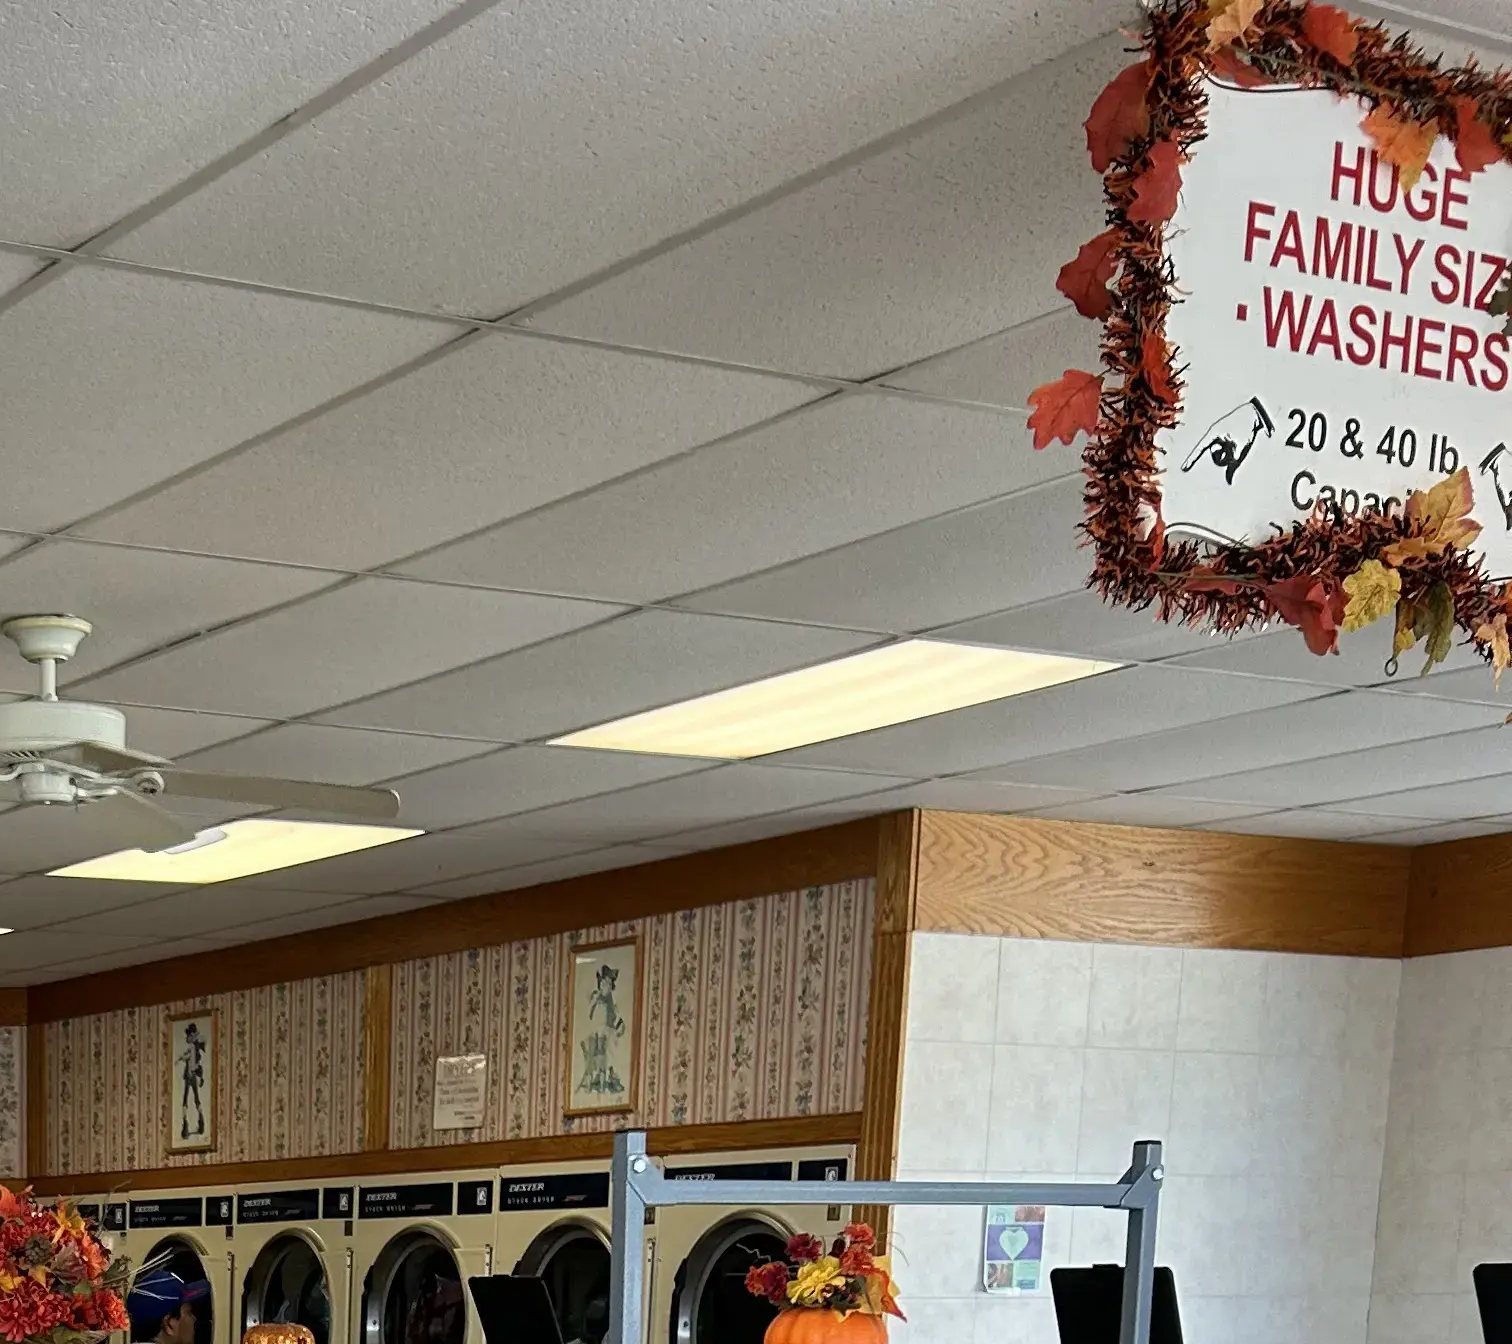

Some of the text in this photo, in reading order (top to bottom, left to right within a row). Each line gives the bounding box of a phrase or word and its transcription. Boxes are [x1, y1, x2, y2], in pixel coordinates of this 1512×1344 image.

[1331, 141, 1471, 231] HUGE
[1244, 201, 1508, 313] FAMILY SIZ
[1263, 286, 1510, 392] WASHERS
[1285, 408, 1459, 475] 20 & 40 lb
[508, 1182, 545, 1193] DEXTER
